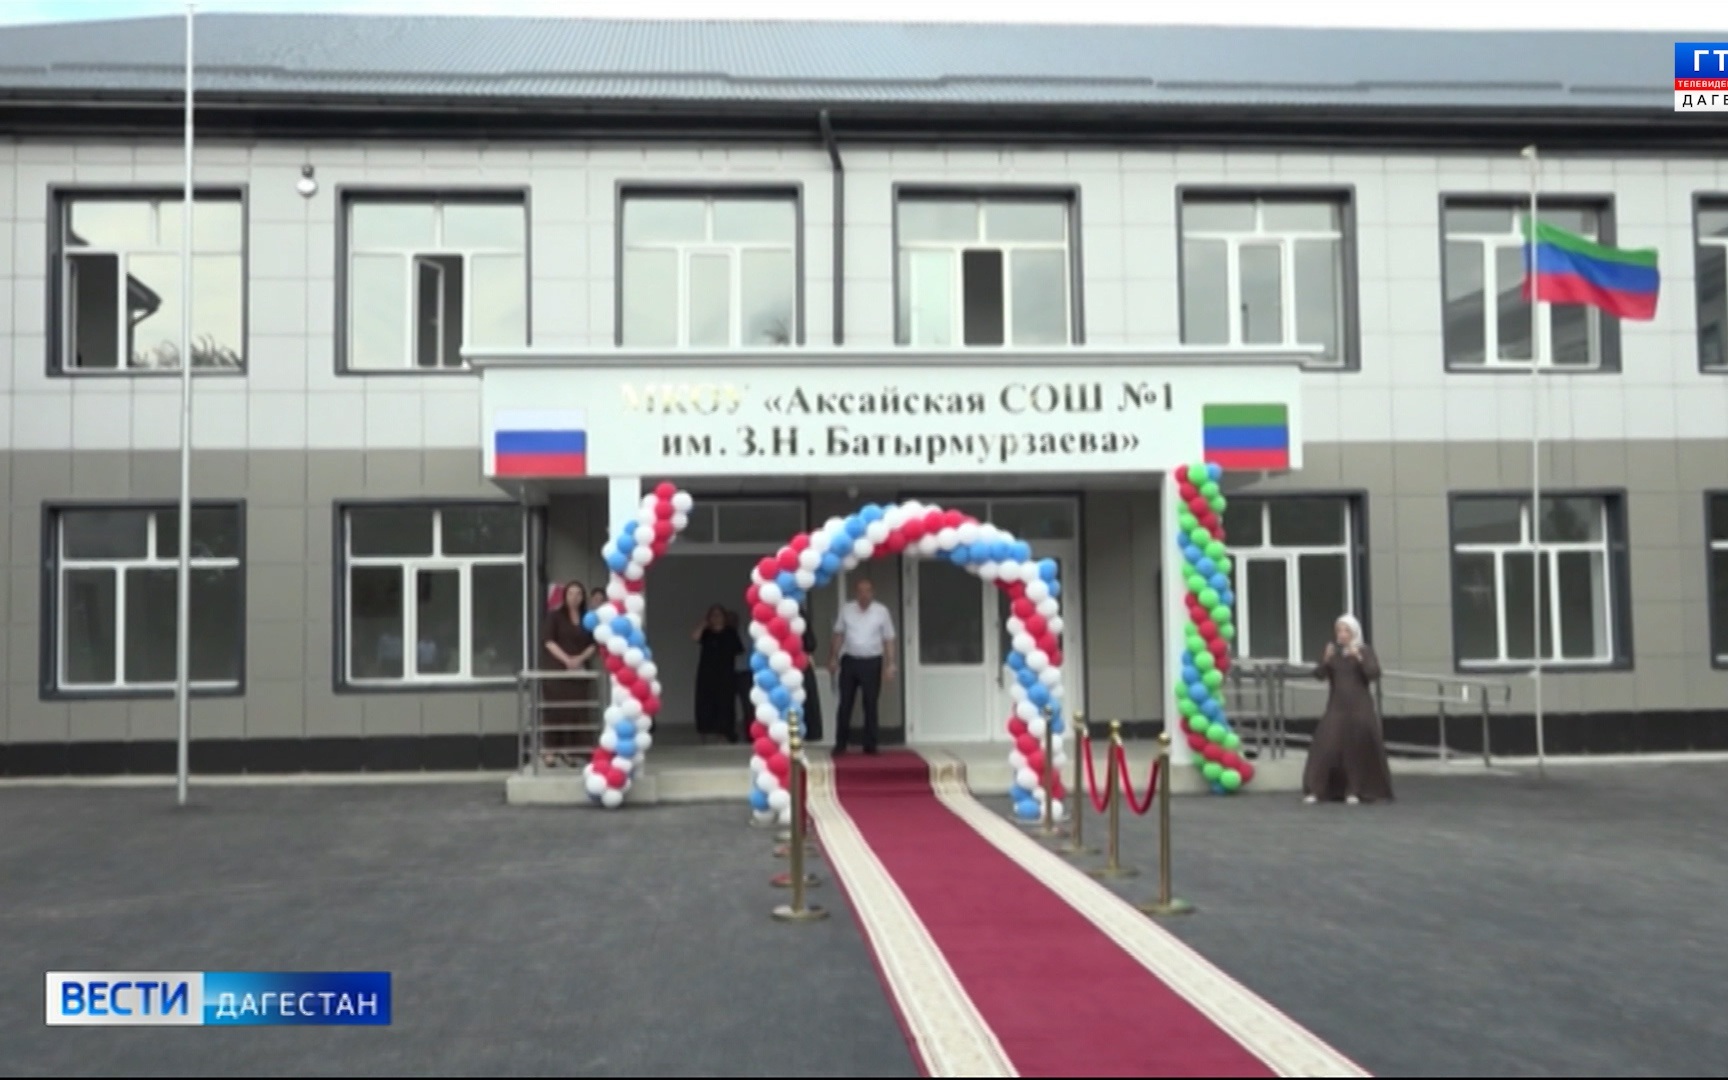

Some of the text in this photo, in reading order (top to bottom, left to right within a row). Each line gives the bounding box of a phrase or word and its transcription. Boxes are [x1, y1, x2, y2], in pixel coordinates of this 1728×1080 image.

[763, 384, 987, 415] «Аксайская
[999, 381, 1103, 414] СОШ
[1117, 381, 1174, 412] №1
[661, 433, 727, 457] им.
[825, 424, 1140, 465] Батырмурзаева»
